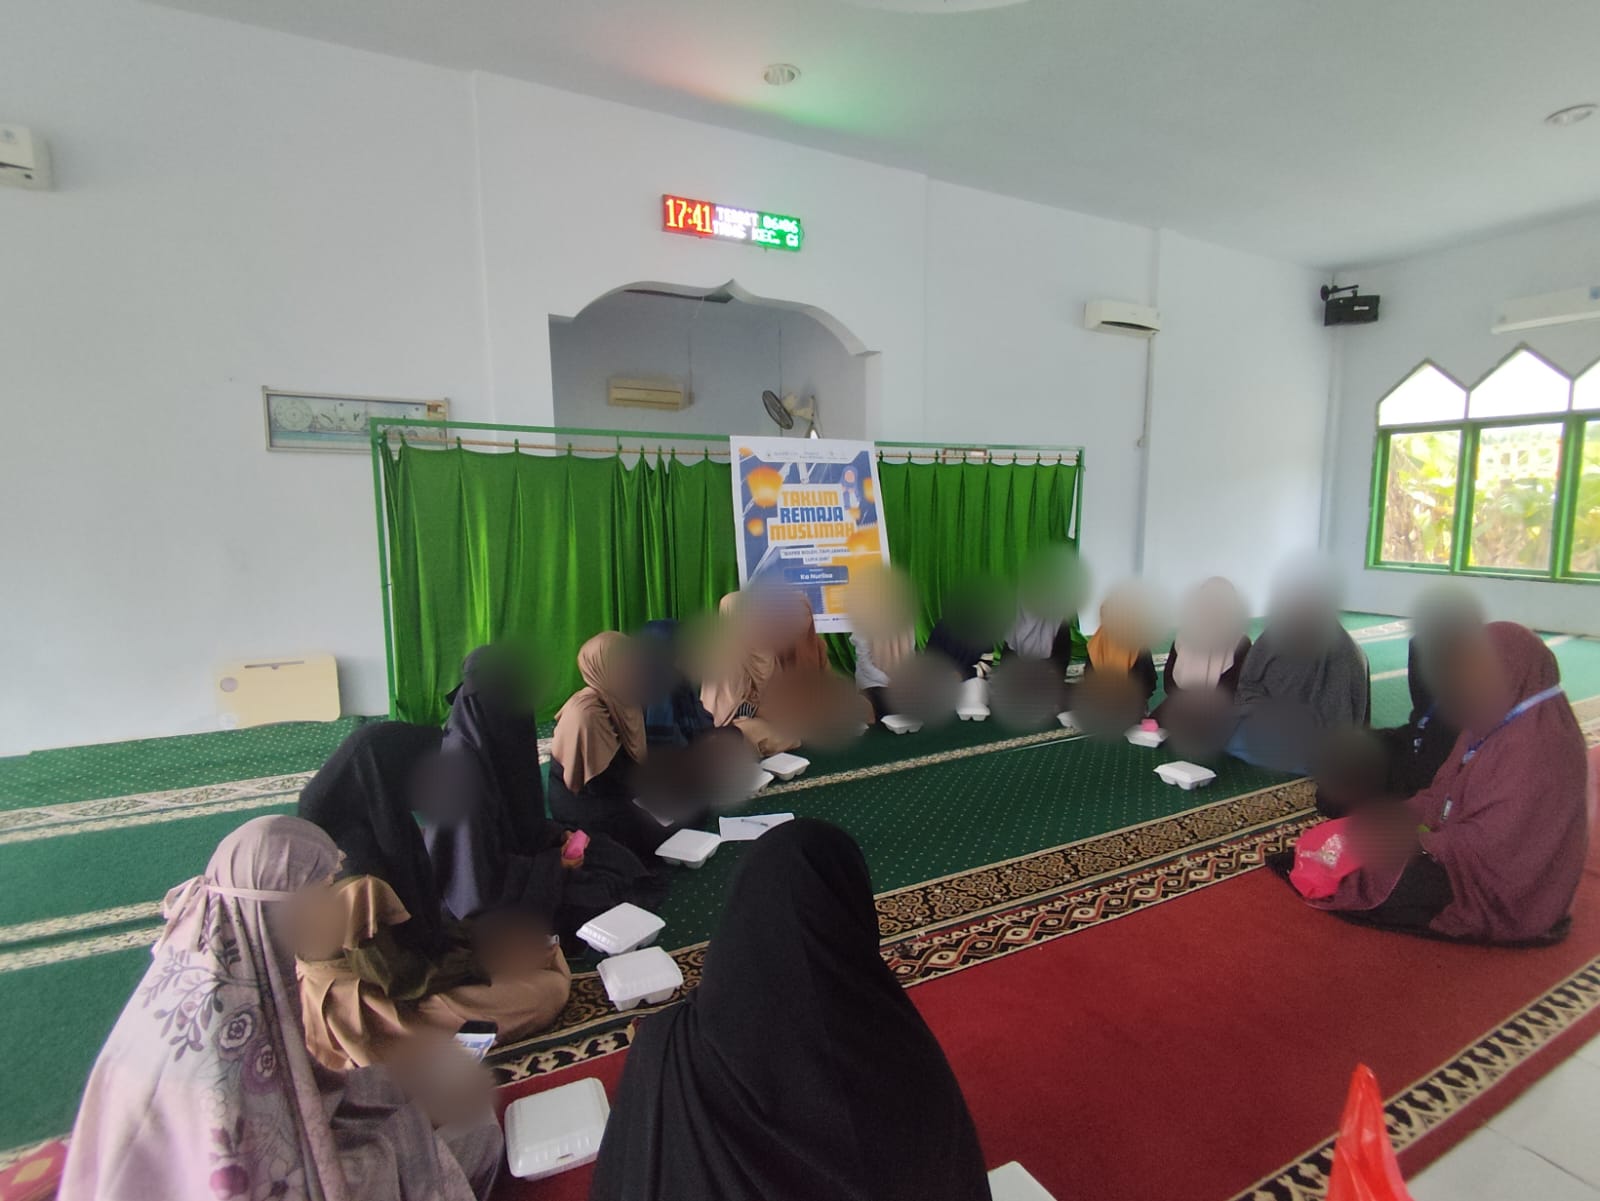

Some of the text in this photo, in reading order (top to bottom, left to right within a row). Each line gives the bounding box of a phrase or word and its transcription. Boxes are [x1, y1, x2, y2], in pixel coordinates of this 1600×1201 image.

[665, 199, 713, 233] 17:41
[782, 490, 838, 506] TAKLIM
[780, 507, 844, 524] REMAJA
[770, 523, 855, 540] MUSLIMAH
